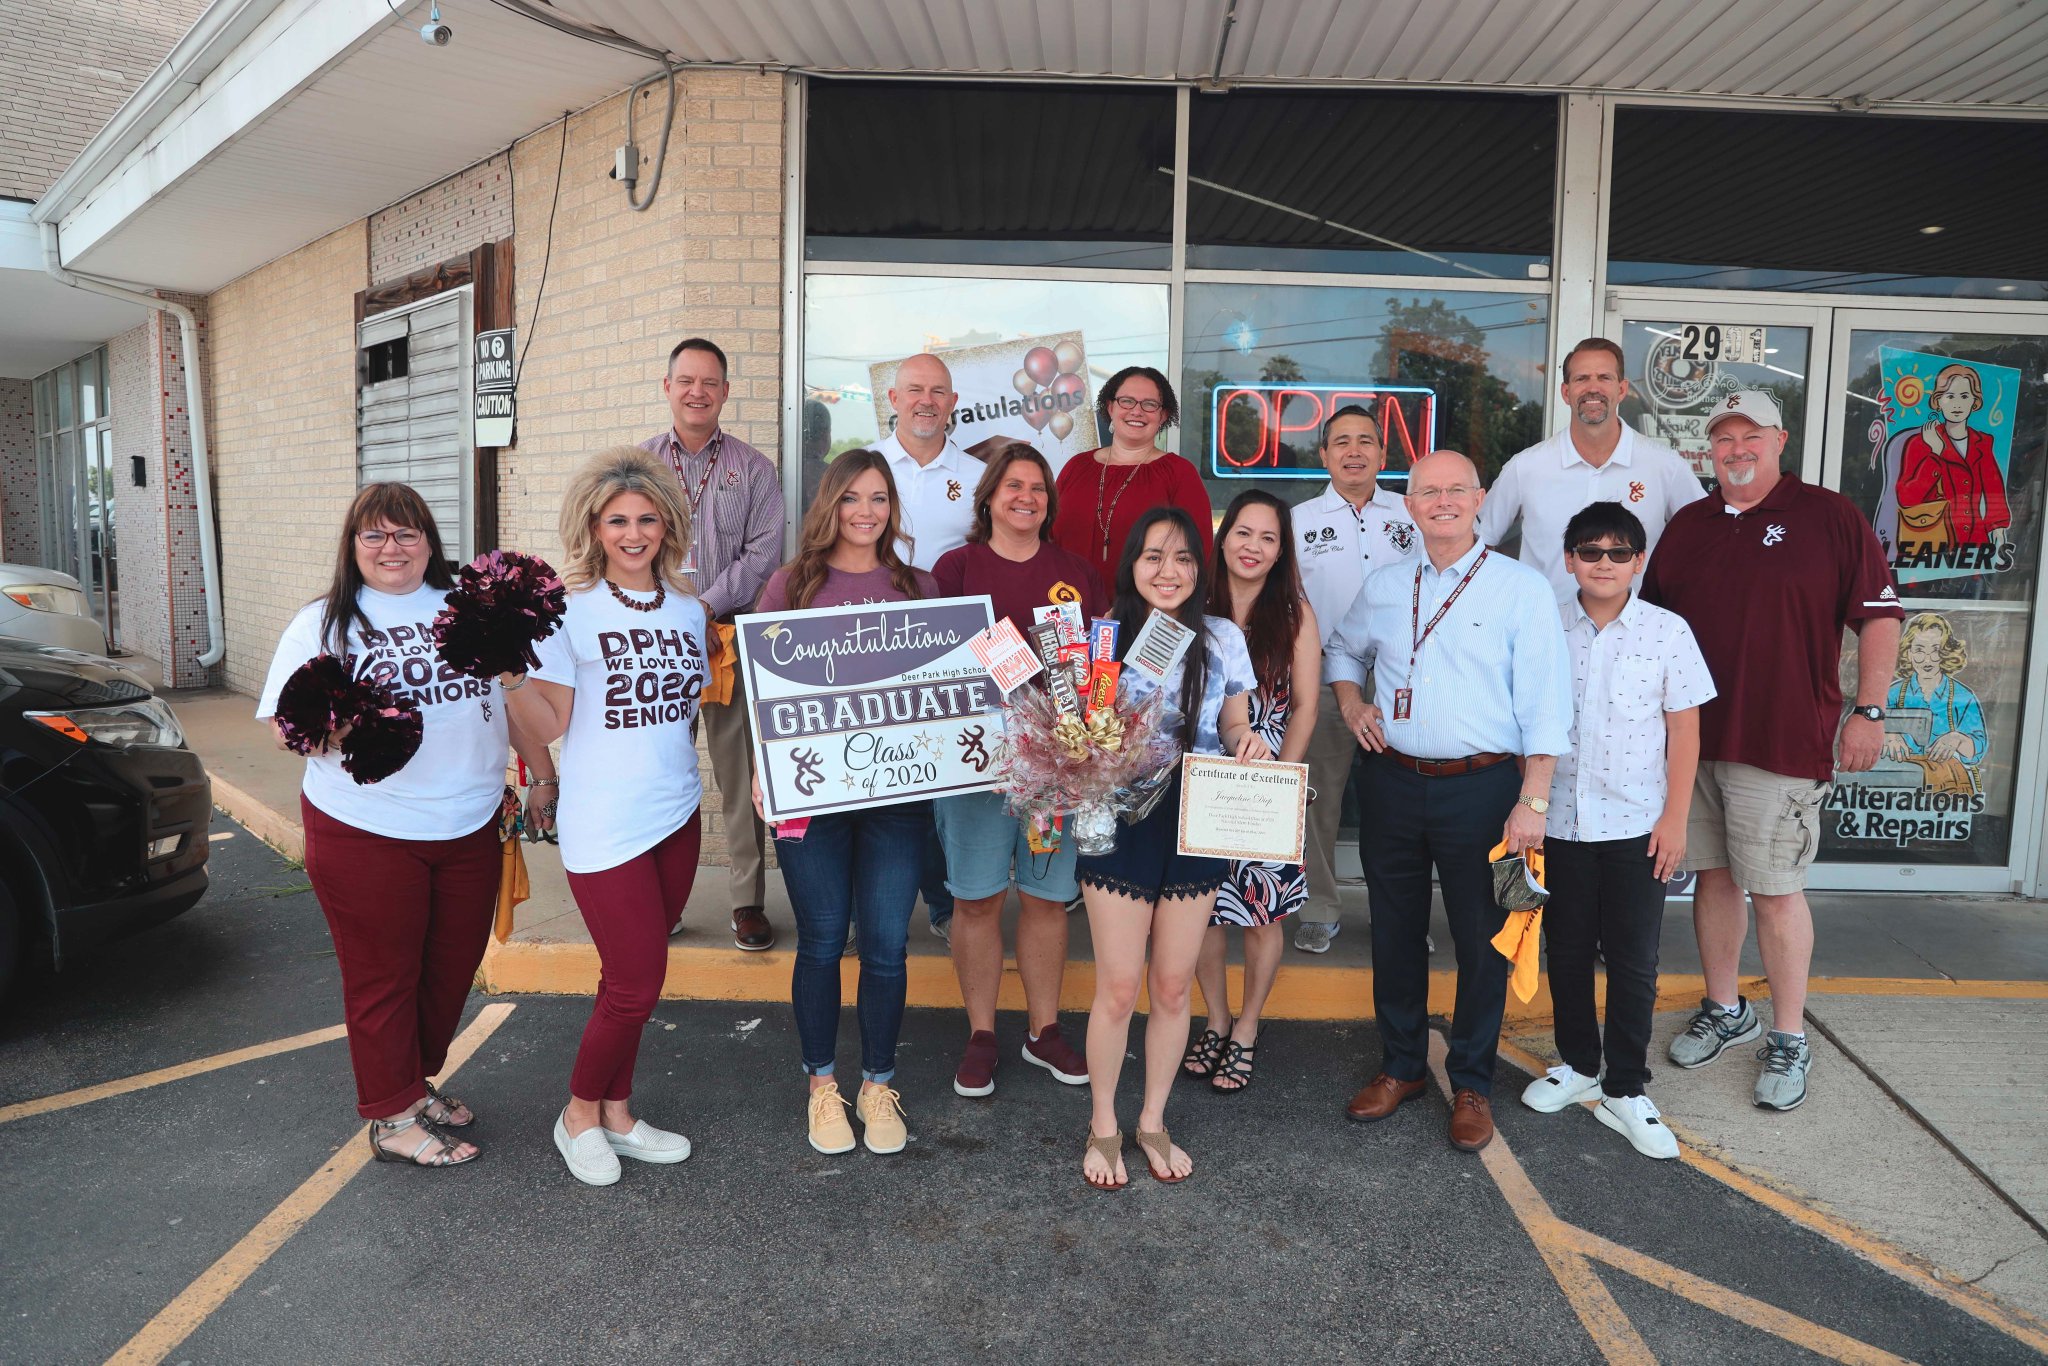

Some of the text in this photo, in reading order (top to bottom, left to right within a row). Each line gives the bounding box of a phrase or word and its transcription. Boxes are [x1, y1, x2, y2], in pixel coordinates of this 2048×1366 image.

[480, 339, 490, 359] NO
[479, 360, 511, 380] PARKING
[477, 394, 512, 416] CAUTION
[1882, 540, 2015, 571] LEANERS
[357, 622, 436, 650] DPH
[598, 628, 702, 660] DPHS
[771, 613, 961, 684] Congratulations
[369, 644, 437, 659] WE LOV
[605, 657, 634, 671] WE
[639, 657, 678, 670] LOVE
[606, 671, 704, 707] 2020
[901, 665, 987, 683] Deer Park High Schoo
[391, 678, 492, 708] ENIORS
[771, 680, 991, 736] GRADUATE
[843, 732, 918, 771] Class
[862, 761, 938, 798] of 2020
[1190, 766, 1298, 786] Certificate of Excellence
[1827, 782, 1985, 813] Alterations
[1838, 811, 1969, 846] & Repairs
